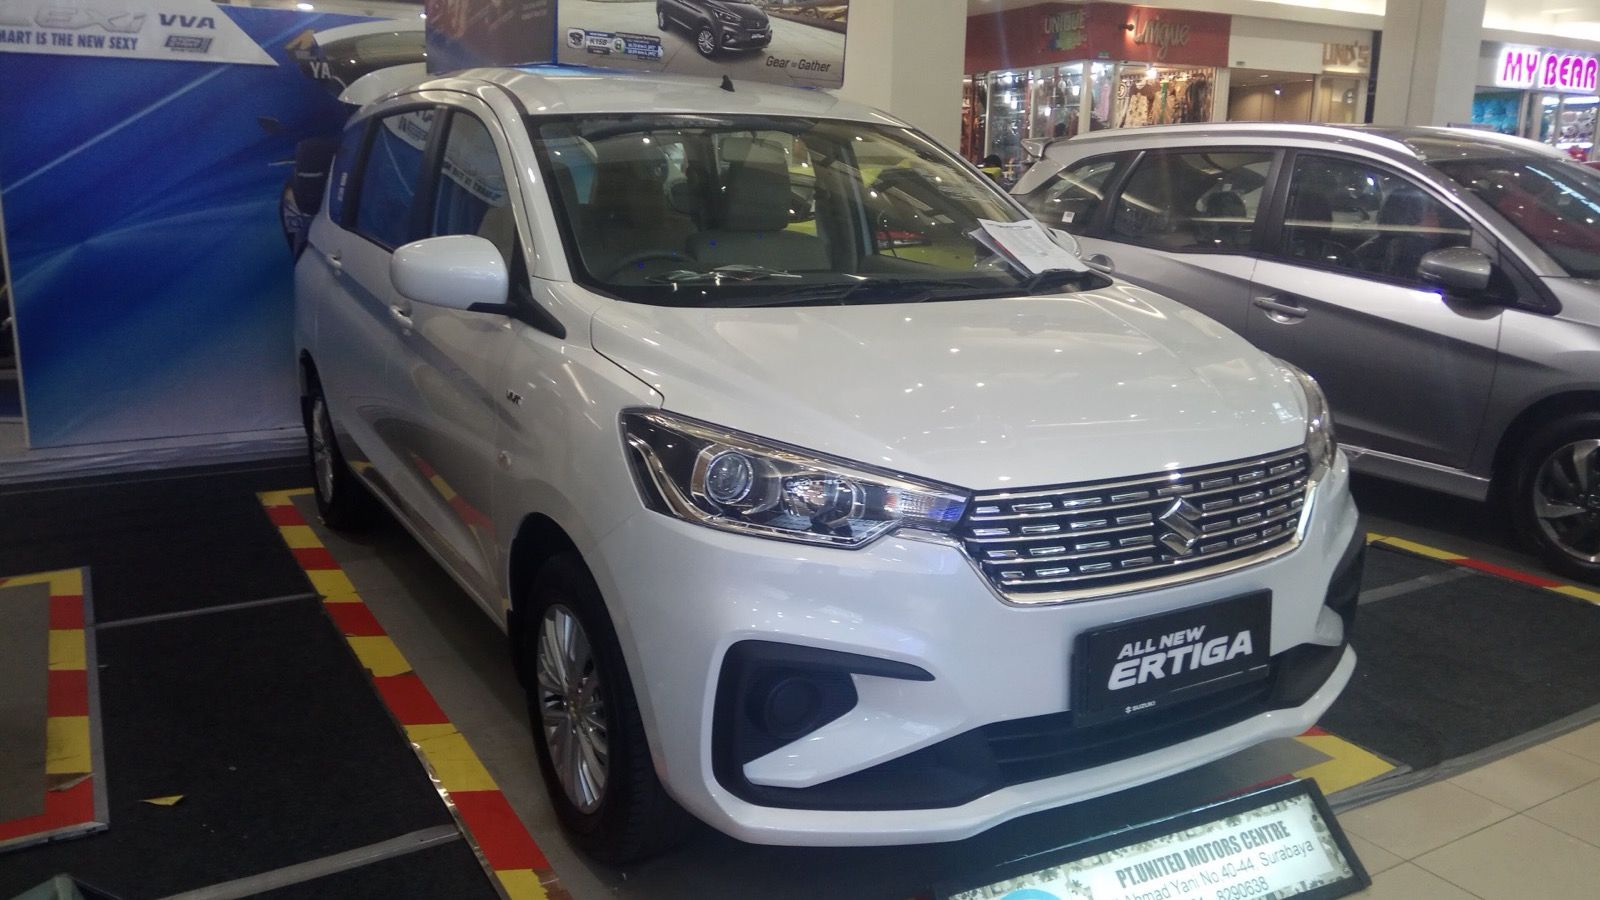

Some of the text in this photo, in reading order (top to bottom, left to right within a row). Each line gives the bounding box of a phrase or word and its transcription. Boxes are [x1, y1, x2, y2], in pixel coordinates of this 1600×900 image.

[159, 13, 216, 29] VVA
[36, 31, 47, 45] IS
[51, 32, 73, 47] THE
[78, 34, 105, 49] NEW
[109, 36, 138, 50] SEXY
[766, 56, 790, 68] Gear
[798, 59, 831, 72] Gather
[1503, 52, 1598, 89] MY BEAR
[1117, 625, 1206, 660] ALL NEW
[1107, 630, 1253, 691] ERTIGA
[1132, 700, 1156, 711] SUZUKI
[1115, 820, 1291, 889] PT.UNITED MOTORS CENTRE
[1169, 876, 1199, 895] Yani
[1259, 840, 1314, 867] Surabaya
[1216, 876, 1269, 900] 8290638
